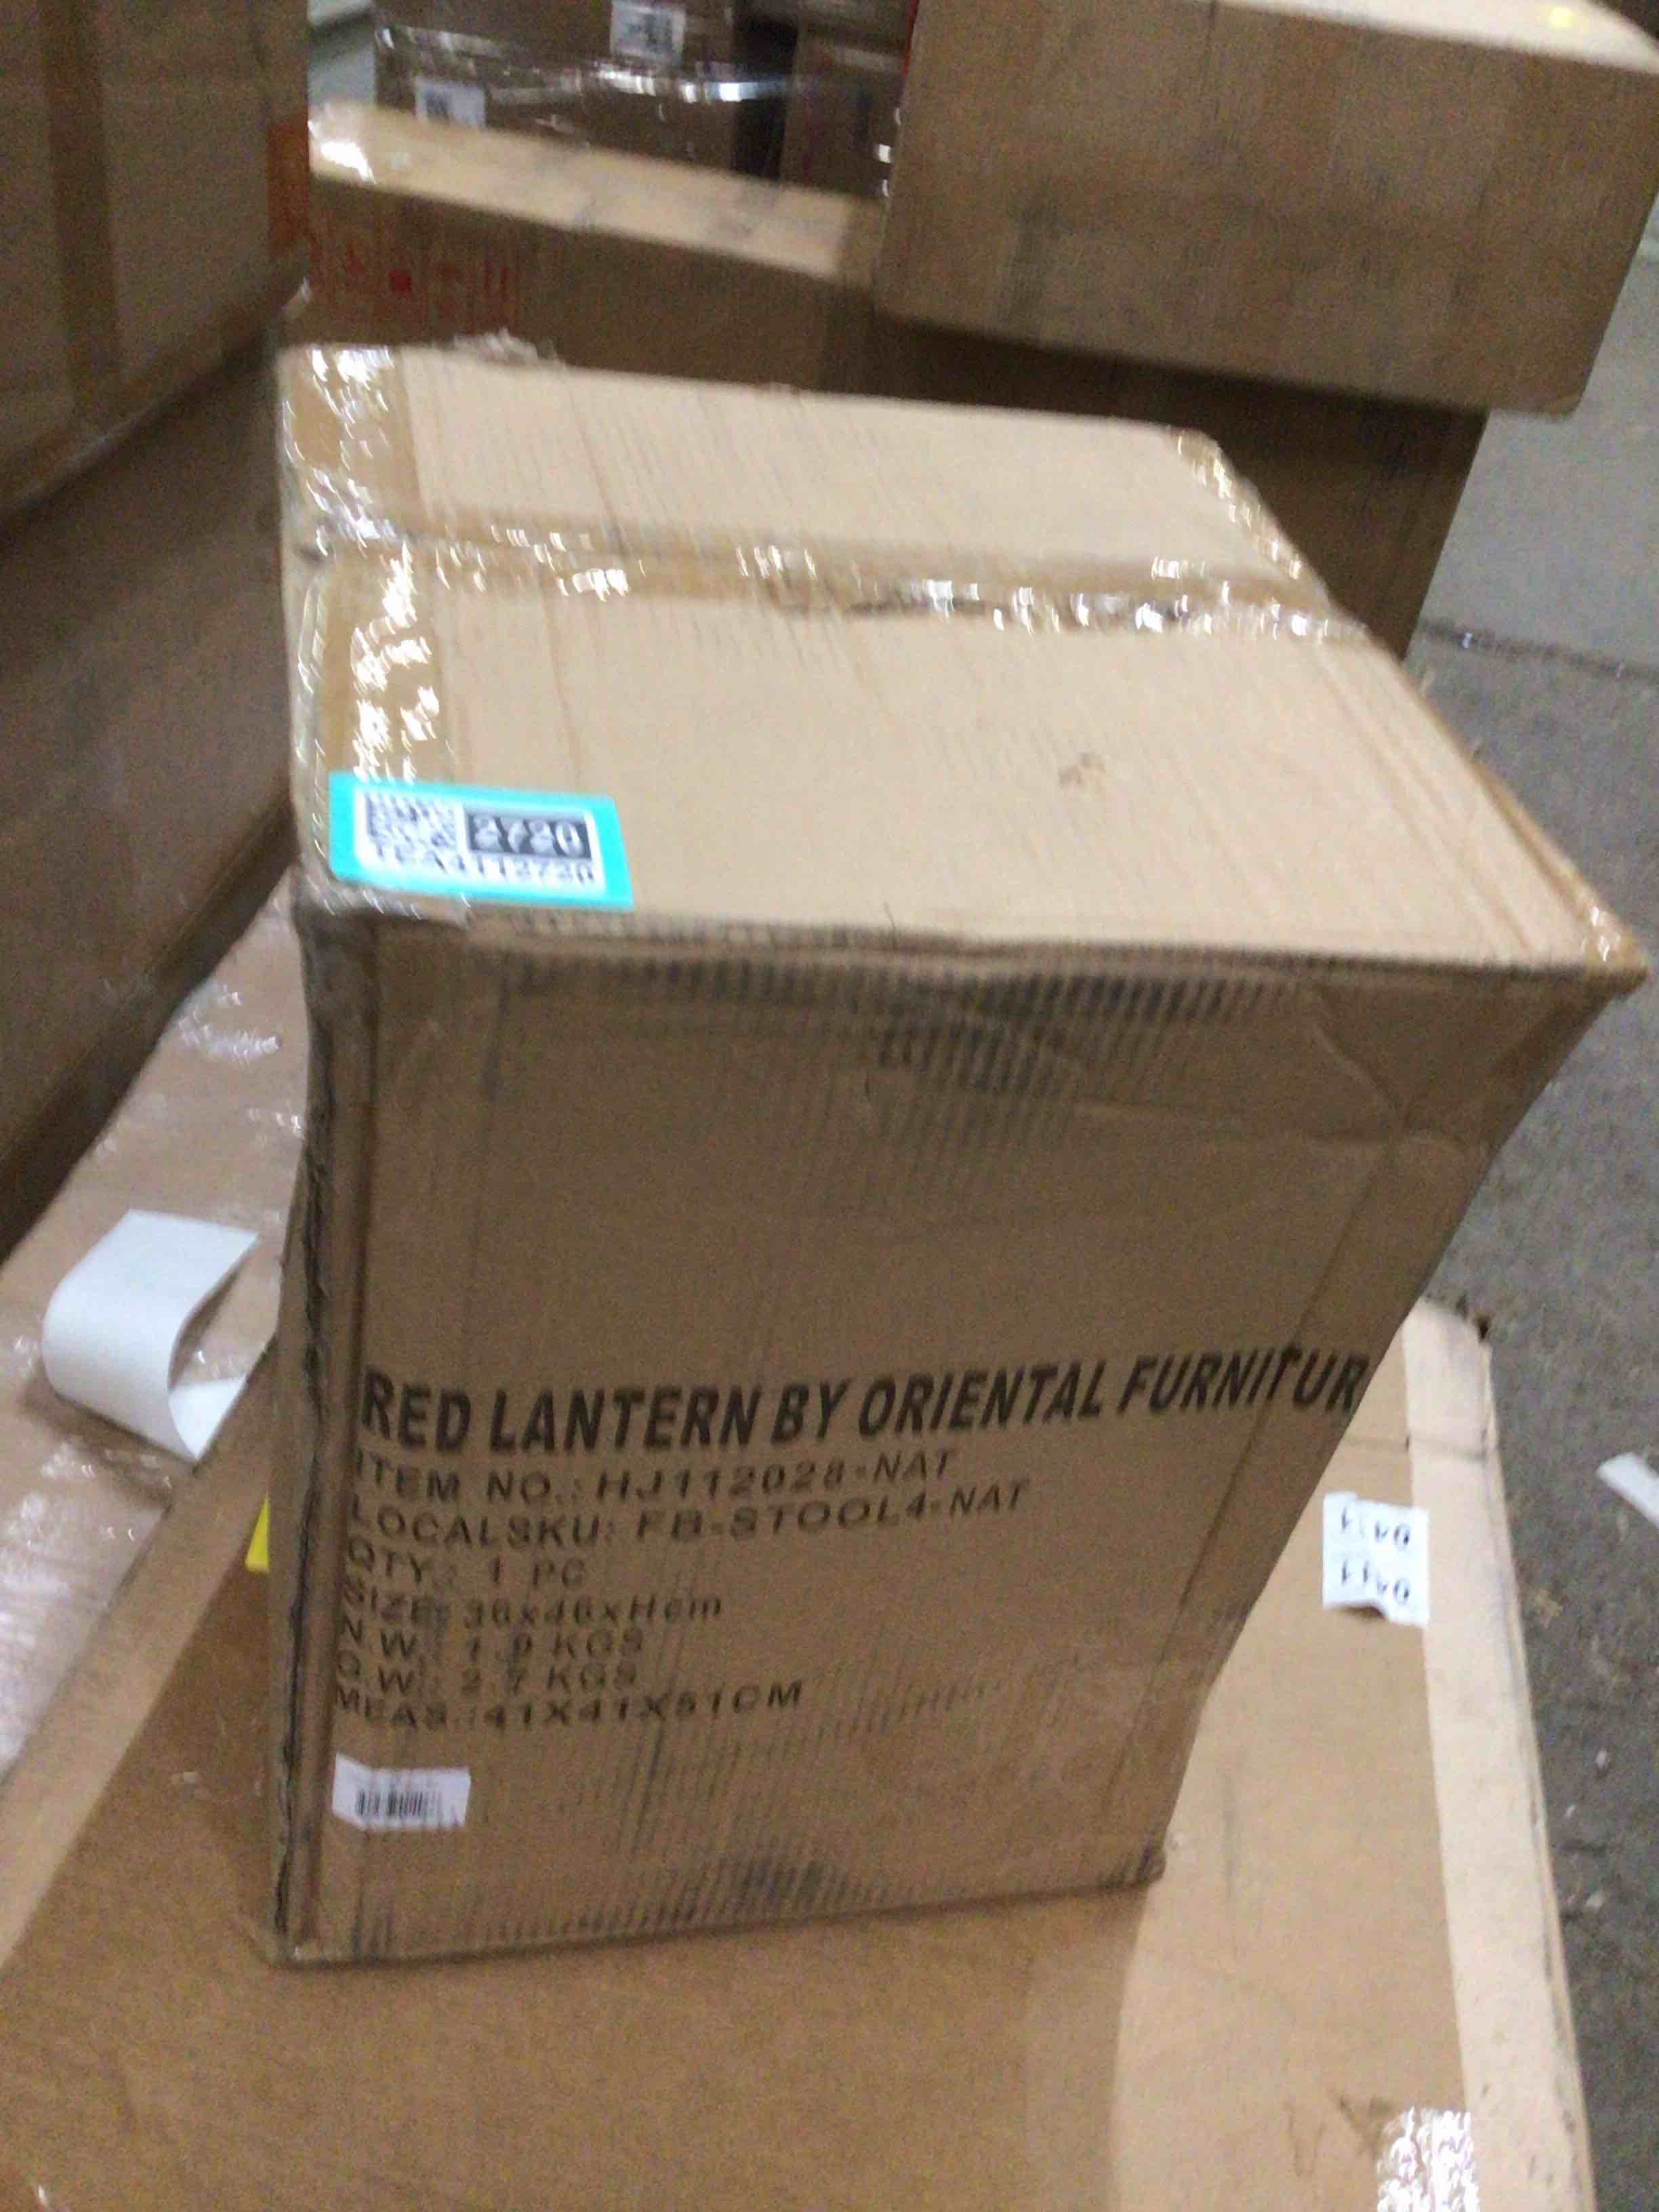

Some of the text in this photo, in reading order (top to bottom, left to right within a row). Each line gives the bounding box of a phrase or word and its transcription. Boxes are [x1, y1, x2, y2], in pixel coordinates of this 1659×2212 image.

[361, 1362, 473, 1454] RED
[488, 1382, 763, 1454] LANTERN
[770, 1377, 849, 1445] BY
[858, 1358, 1106, 1438] ORIENTAL
[351, 1448, 462, 1502] ITEM
